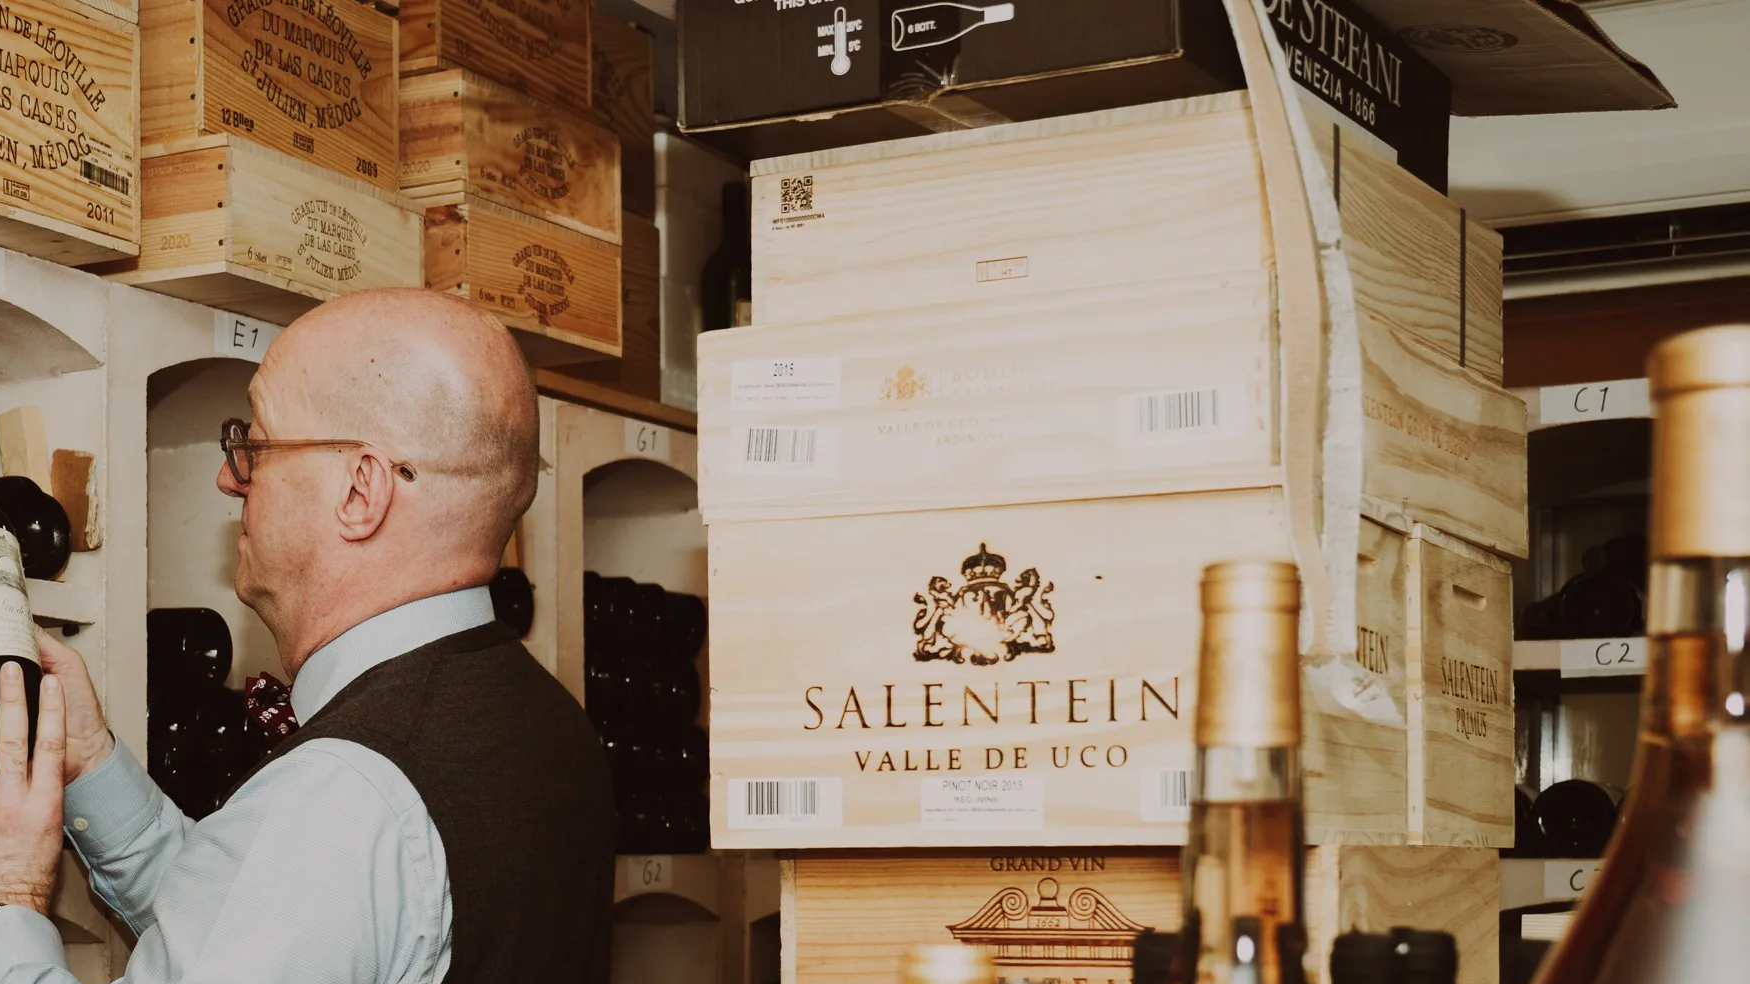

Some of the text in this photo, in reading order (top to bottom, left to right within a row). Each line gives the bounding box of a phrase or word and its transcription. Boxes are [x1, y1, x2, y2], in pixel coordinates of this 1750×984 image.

[261, 9, 345, 65] DU MARQUIS
[14, 16, 32, 38] DE
[34, 21, 106, 113] LÉOVILLE
[1300, 0, 1402, 107] STEFANI
[255, 38, 351, 99] DE LAS CASES
[1284, 41, 1375, 126] VENEZIA 1866
[20, 94, 77, 134] CASES
[221, 108, 232, 127] 12
[316, 97, 362, 130] MÉDOC
[29, 132, 91, 170] MÉDOC
[86, 202, 116, 226] 2011
[161, 233, 191, 250] 2020
[307, 216, 353, 242] DU MARQUIS
[247, 246, 253, 261] 6
[304, 233, 356, 261] DE LAS CASES
[233, 321, 258, 348] E1
[1573, 387, 1609, 413] C1
[1595, 641, 1635, 665] C2
[1441, 656, 1498, 705] SALENTEIN
[804, 676, 1180, 730] SALENTEIN
[1456, 708, 1487, 740] PRIMUS
[854, 744, 1129, 772] VALLE DE UCO
[942, 779, 972, 791] PINOT
[975, 779, 998, 791] NOIR
[990, 857, 1105, 872] GRAND VIN
